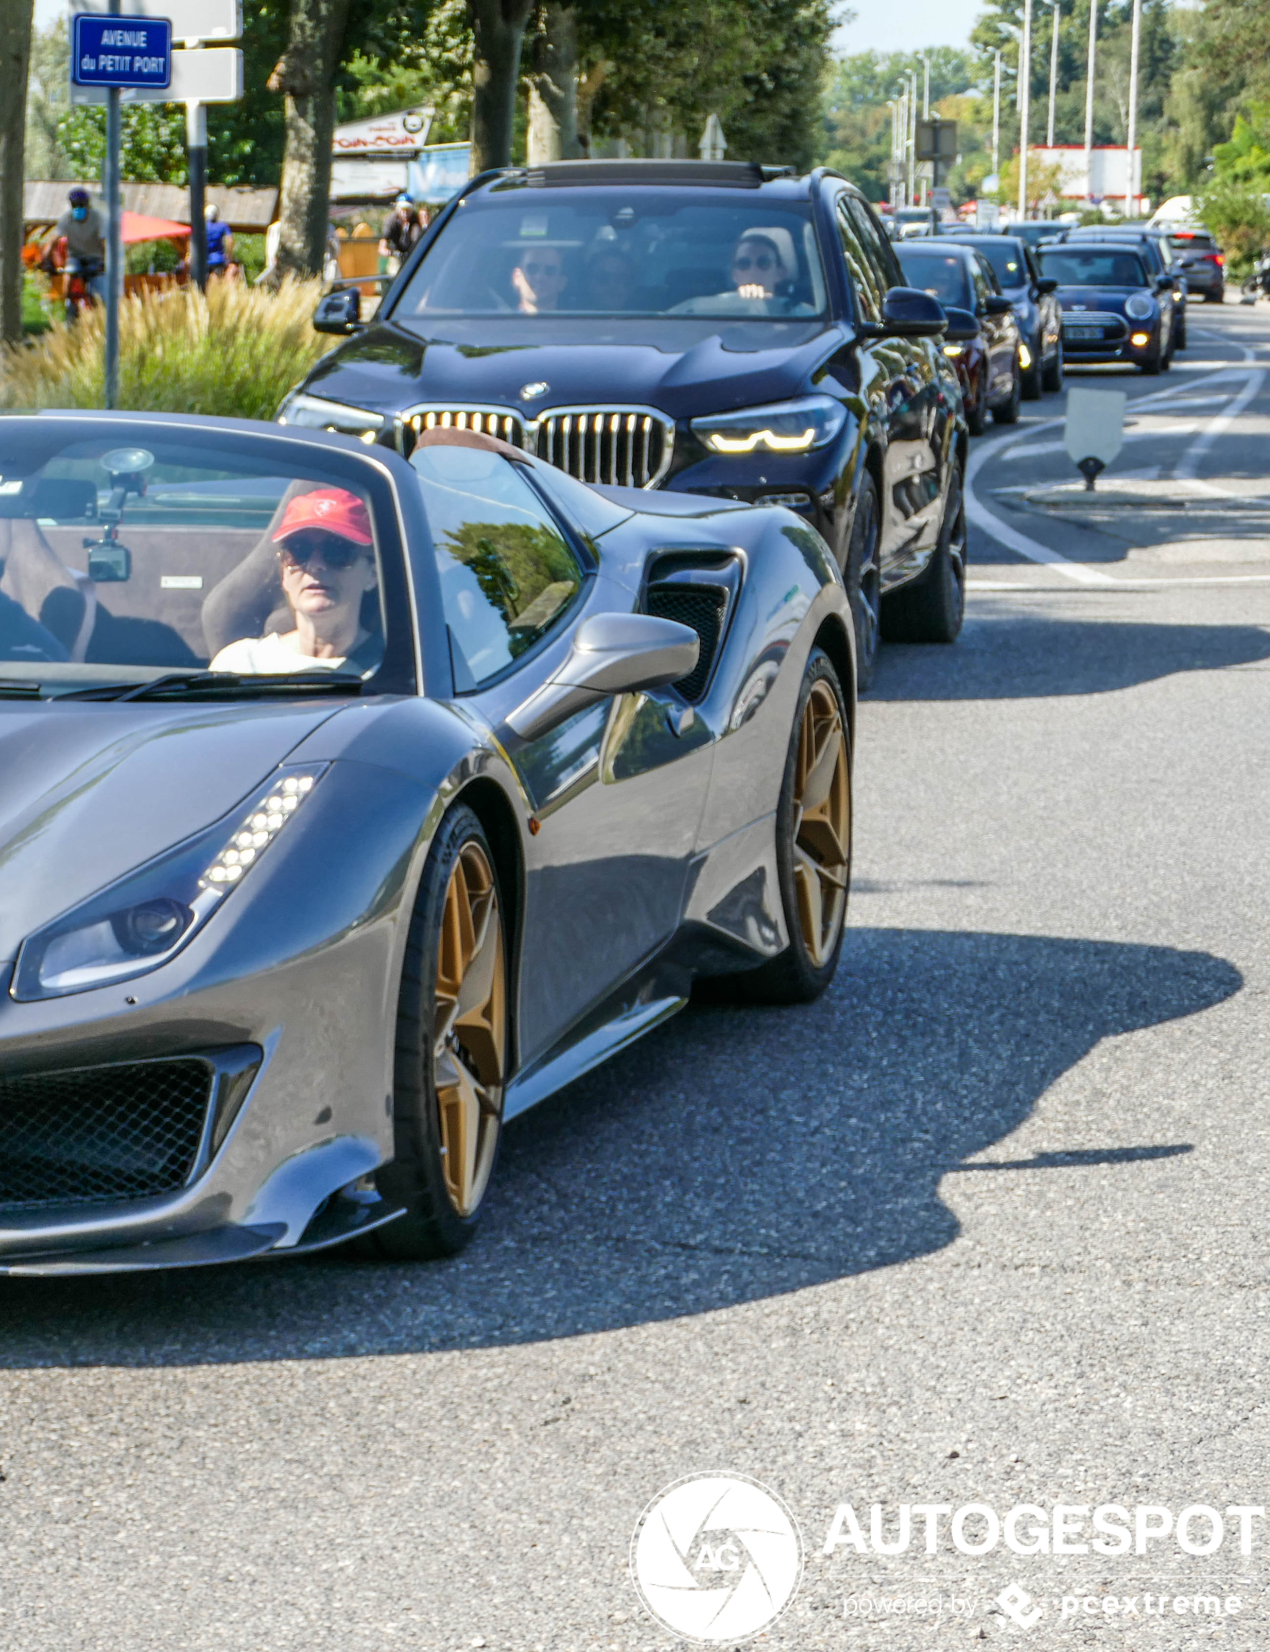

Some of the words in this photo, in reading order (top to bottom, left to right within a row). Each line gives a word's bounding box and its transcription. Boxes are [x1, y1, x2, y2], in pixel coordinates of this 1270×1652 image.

[101, 30, 147, 47] AVENUE
[81, 54, 96, 71] du
[98, 56, 131, 72] PETIT
[133, 57, 165, 73] PORT
